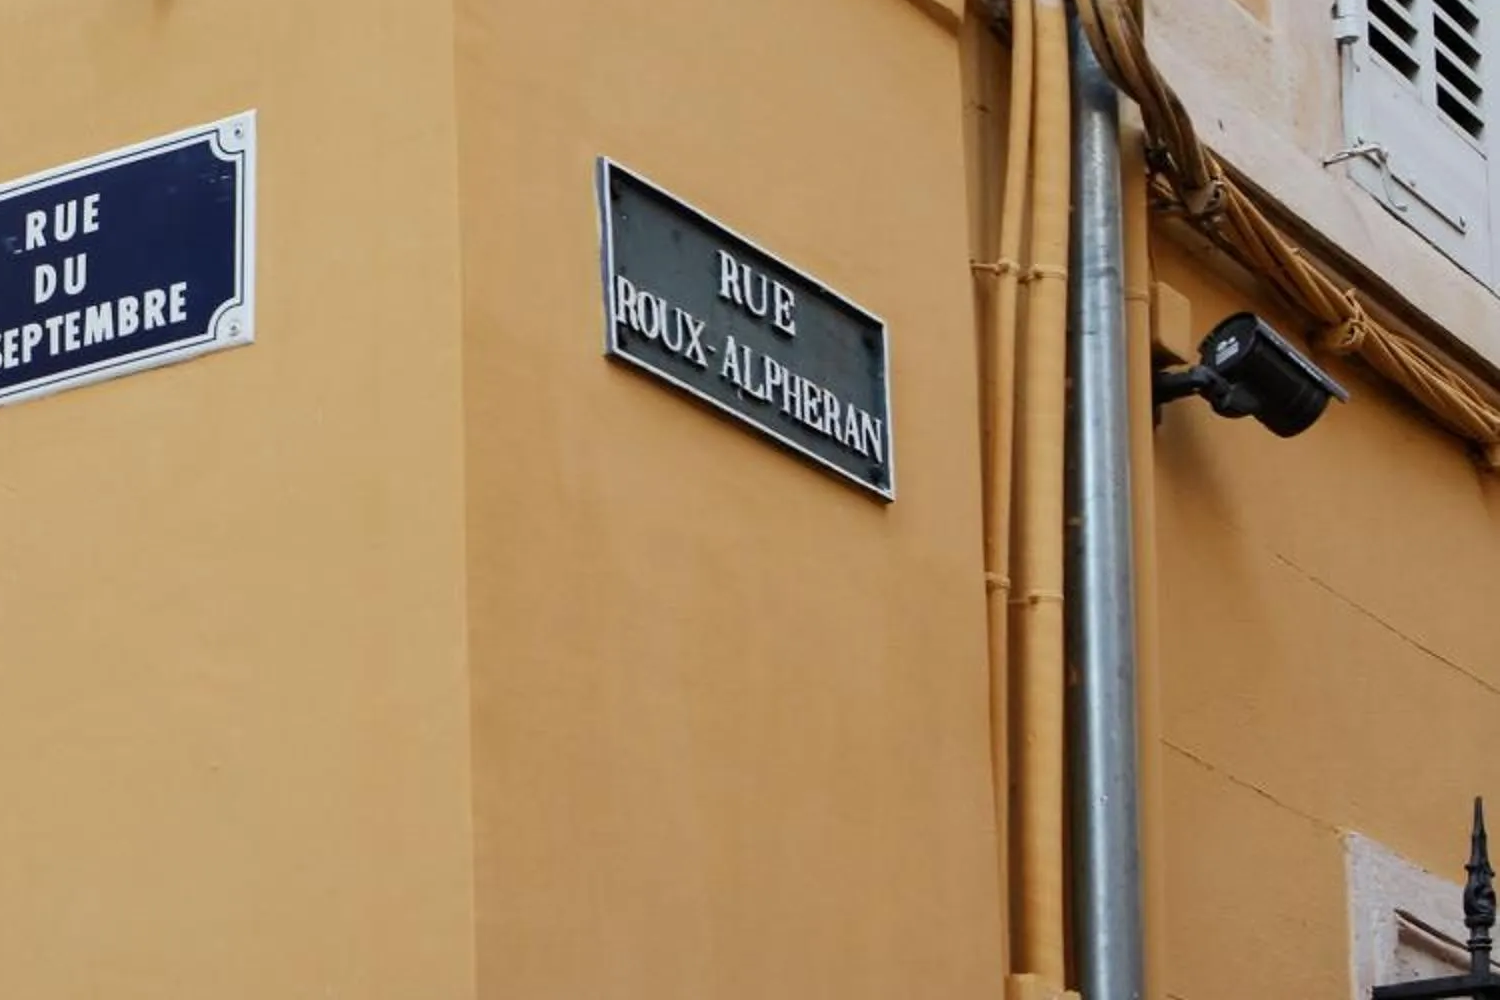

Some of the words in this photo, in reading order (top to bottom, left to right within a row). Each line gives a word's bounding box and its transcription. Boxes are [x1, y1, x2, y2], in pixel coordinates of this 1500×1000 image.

[25, 194, 100, 251] RUE
[34, 253, 87, 304] DU
[717, 249, 797, 336] RUE
